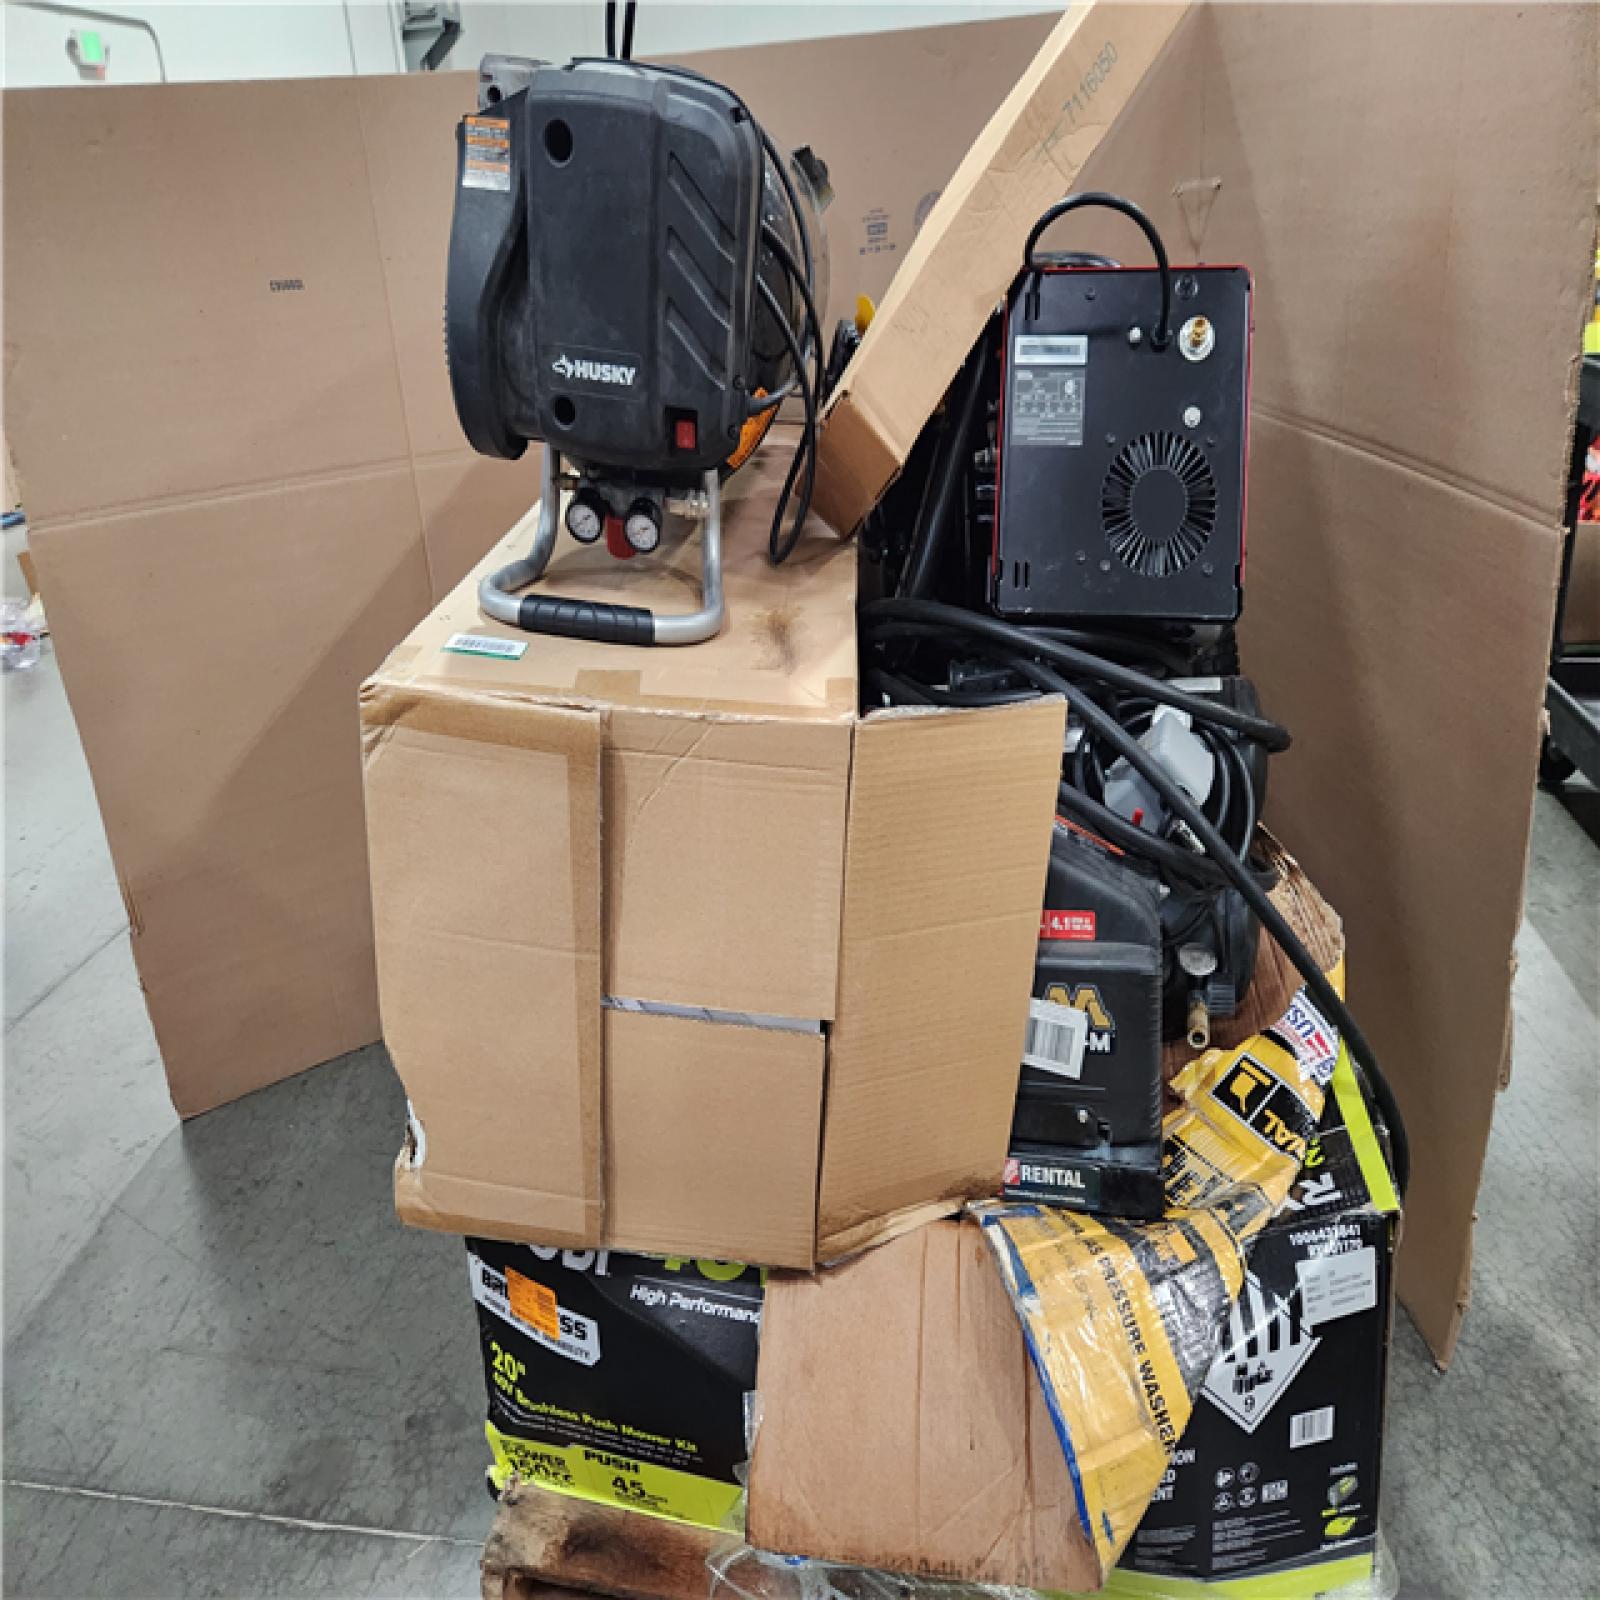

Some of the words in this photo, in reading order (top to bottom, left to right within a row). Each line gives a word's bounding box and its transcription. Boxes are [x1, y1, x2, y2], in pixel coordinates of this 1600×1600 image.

[574, 360, 636, 385] HUSKY
[1020, 1164, 1086, 1188] RENTAL
[630, 1284, 666, 1306] High
[1098, 1255, 1147, 1354] PRESSURE
[584, 1450, 639, 1474] PUSH
